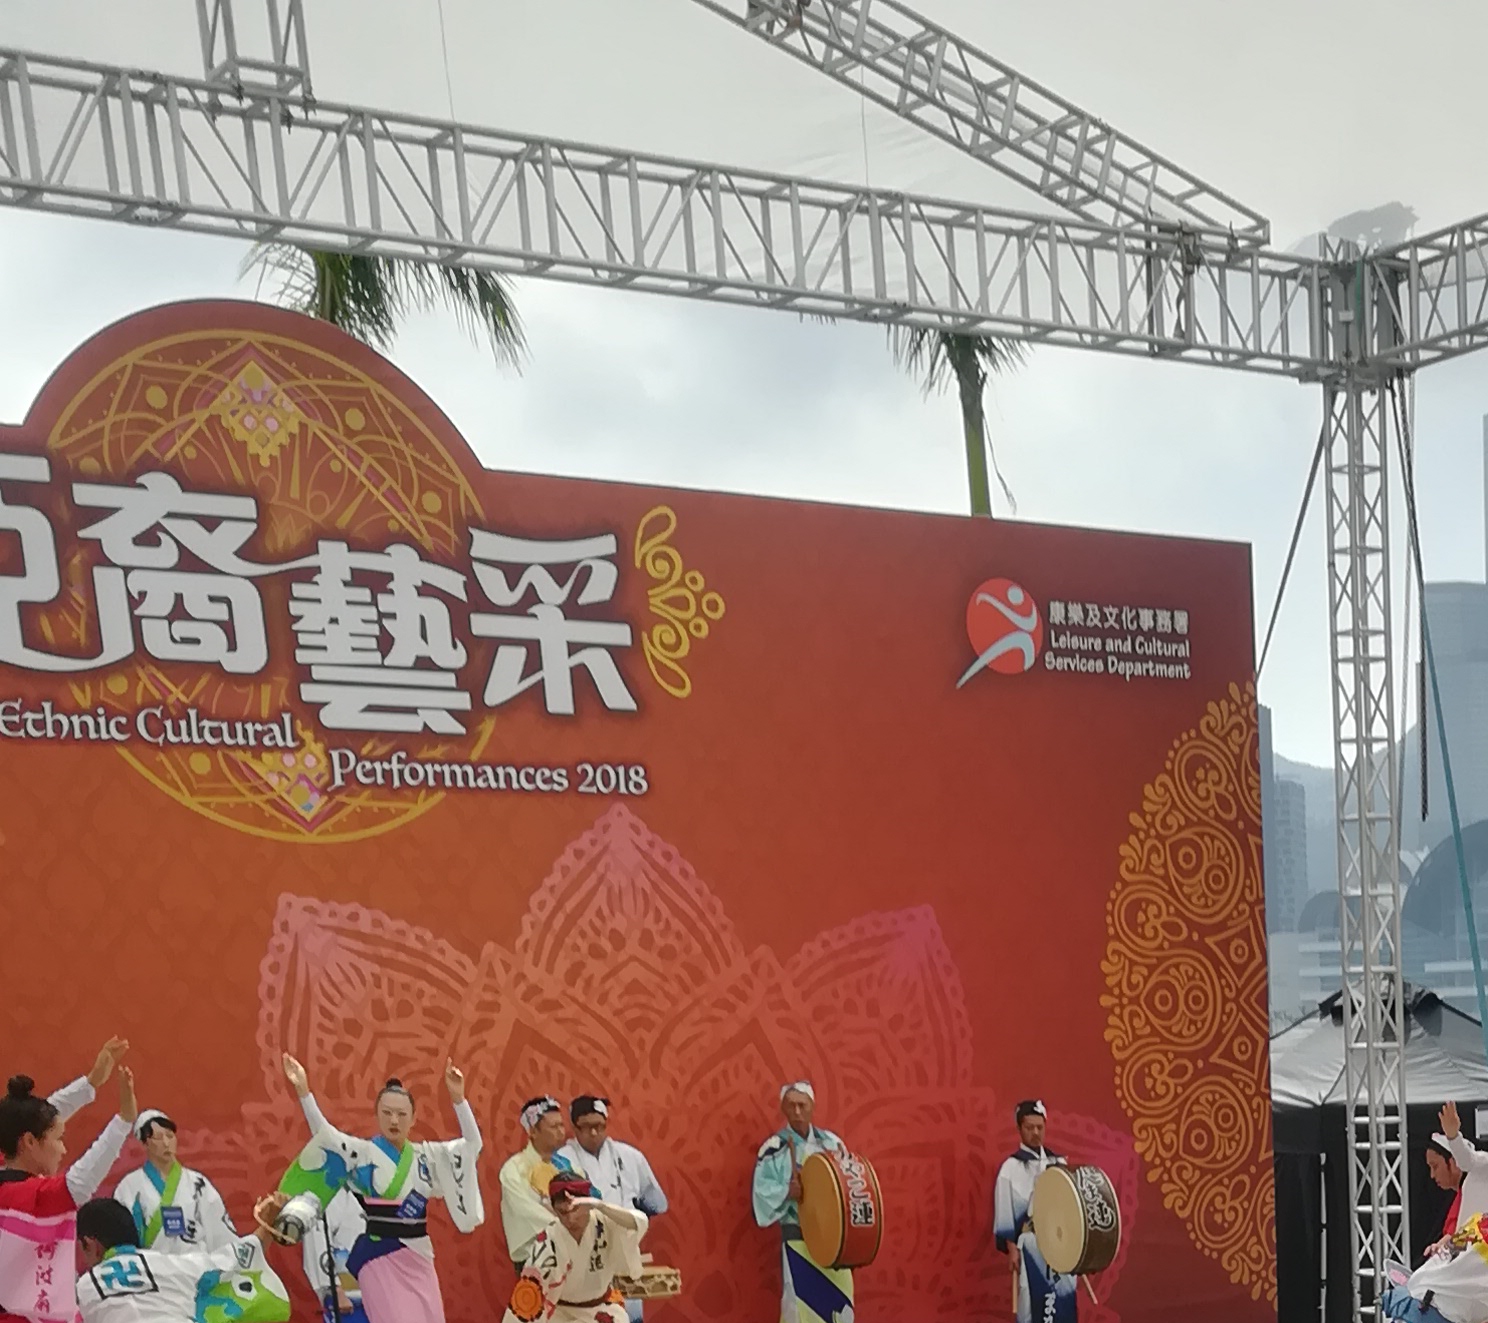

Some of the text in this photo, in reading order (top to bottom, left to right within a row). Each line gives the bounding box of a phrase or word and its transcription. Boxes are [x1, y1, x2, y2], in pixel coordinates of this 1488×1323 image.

[1050, 629, 1190, 658] Leisure and Cultural
[1044, 650, 1191, 682] Services Department
[0, 698, 300, 748] Ethnic Cultural
[327, 747, 649, 795] Performances 2018
